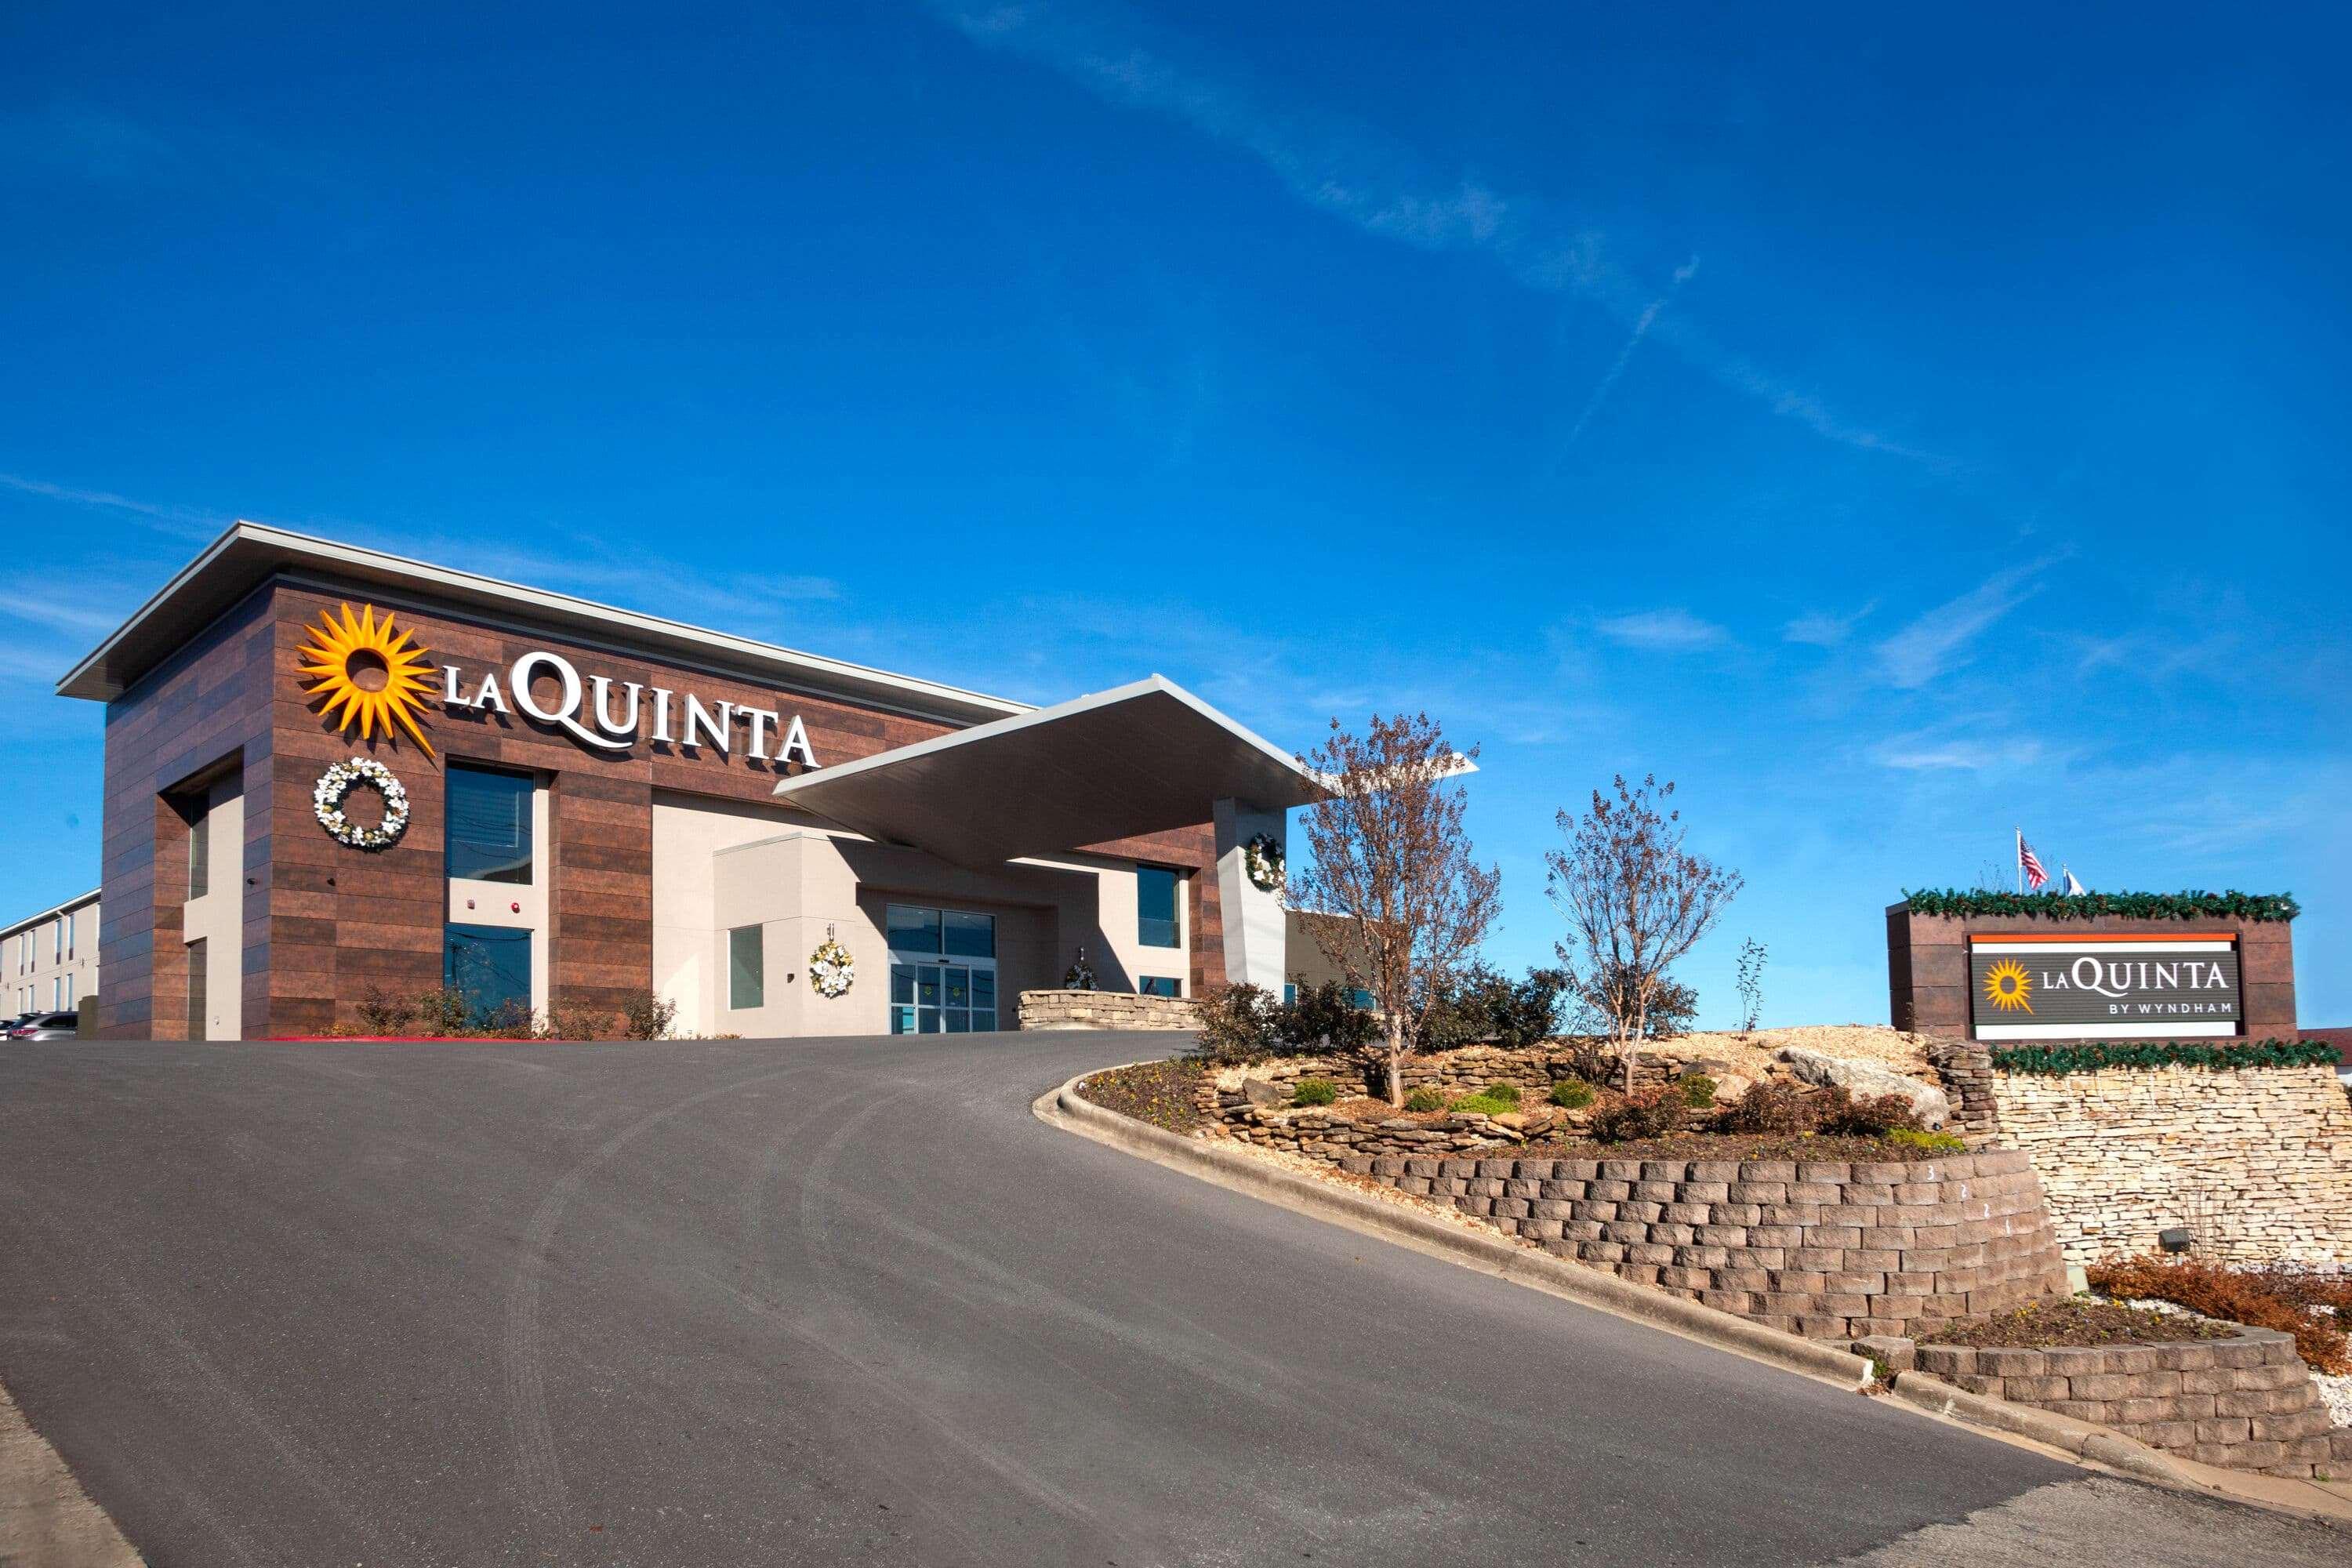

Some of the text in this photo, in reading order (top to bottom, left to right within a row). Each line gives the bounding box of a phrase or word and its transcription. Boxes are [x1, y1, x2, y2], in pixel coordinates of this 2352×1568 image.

[442, 651, 822, 768] LA QUINTA
[2042, 956, 2230, 998] LA QUINTA
[2109, 1003, 2232, 1014] BY WYNDHAM
